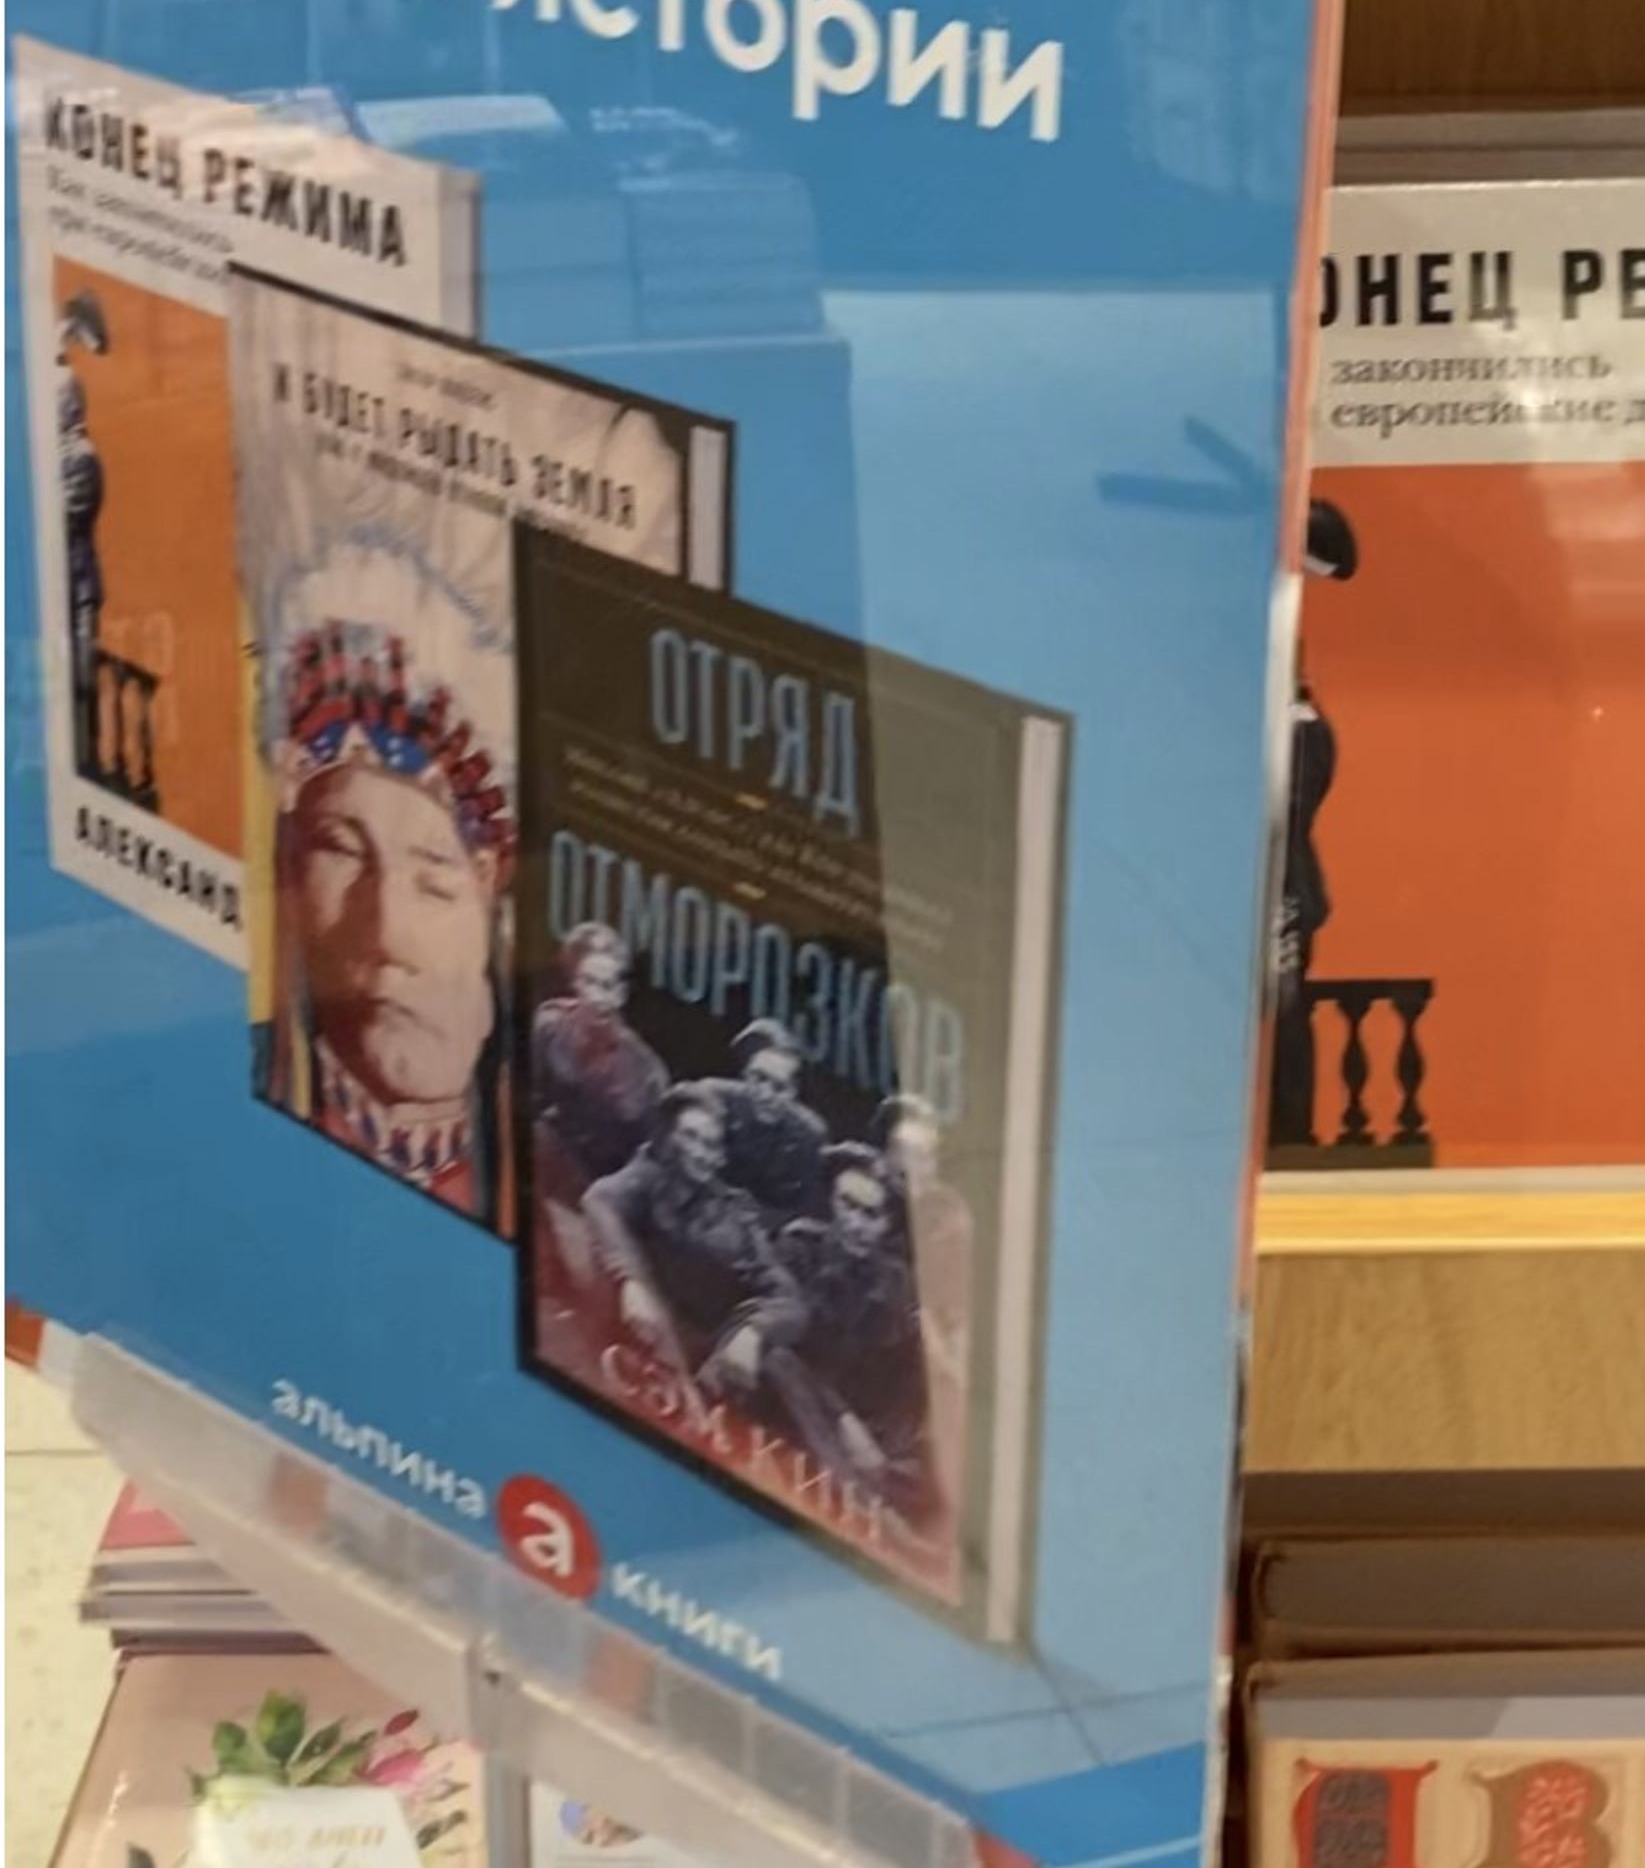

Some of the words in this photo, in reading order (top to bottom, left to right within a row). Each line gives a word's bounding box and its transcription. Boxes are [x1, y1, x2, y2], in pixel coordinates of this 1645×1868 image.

[203, 146, 408, 269] РЕЖИМА
[1330, 349, 1612, 384] закончились
[649, 628, 860, 837] ОТРЯД
[271, 1378, 486, 1522] альпина
[611, 1562, 783, 1682] книги
